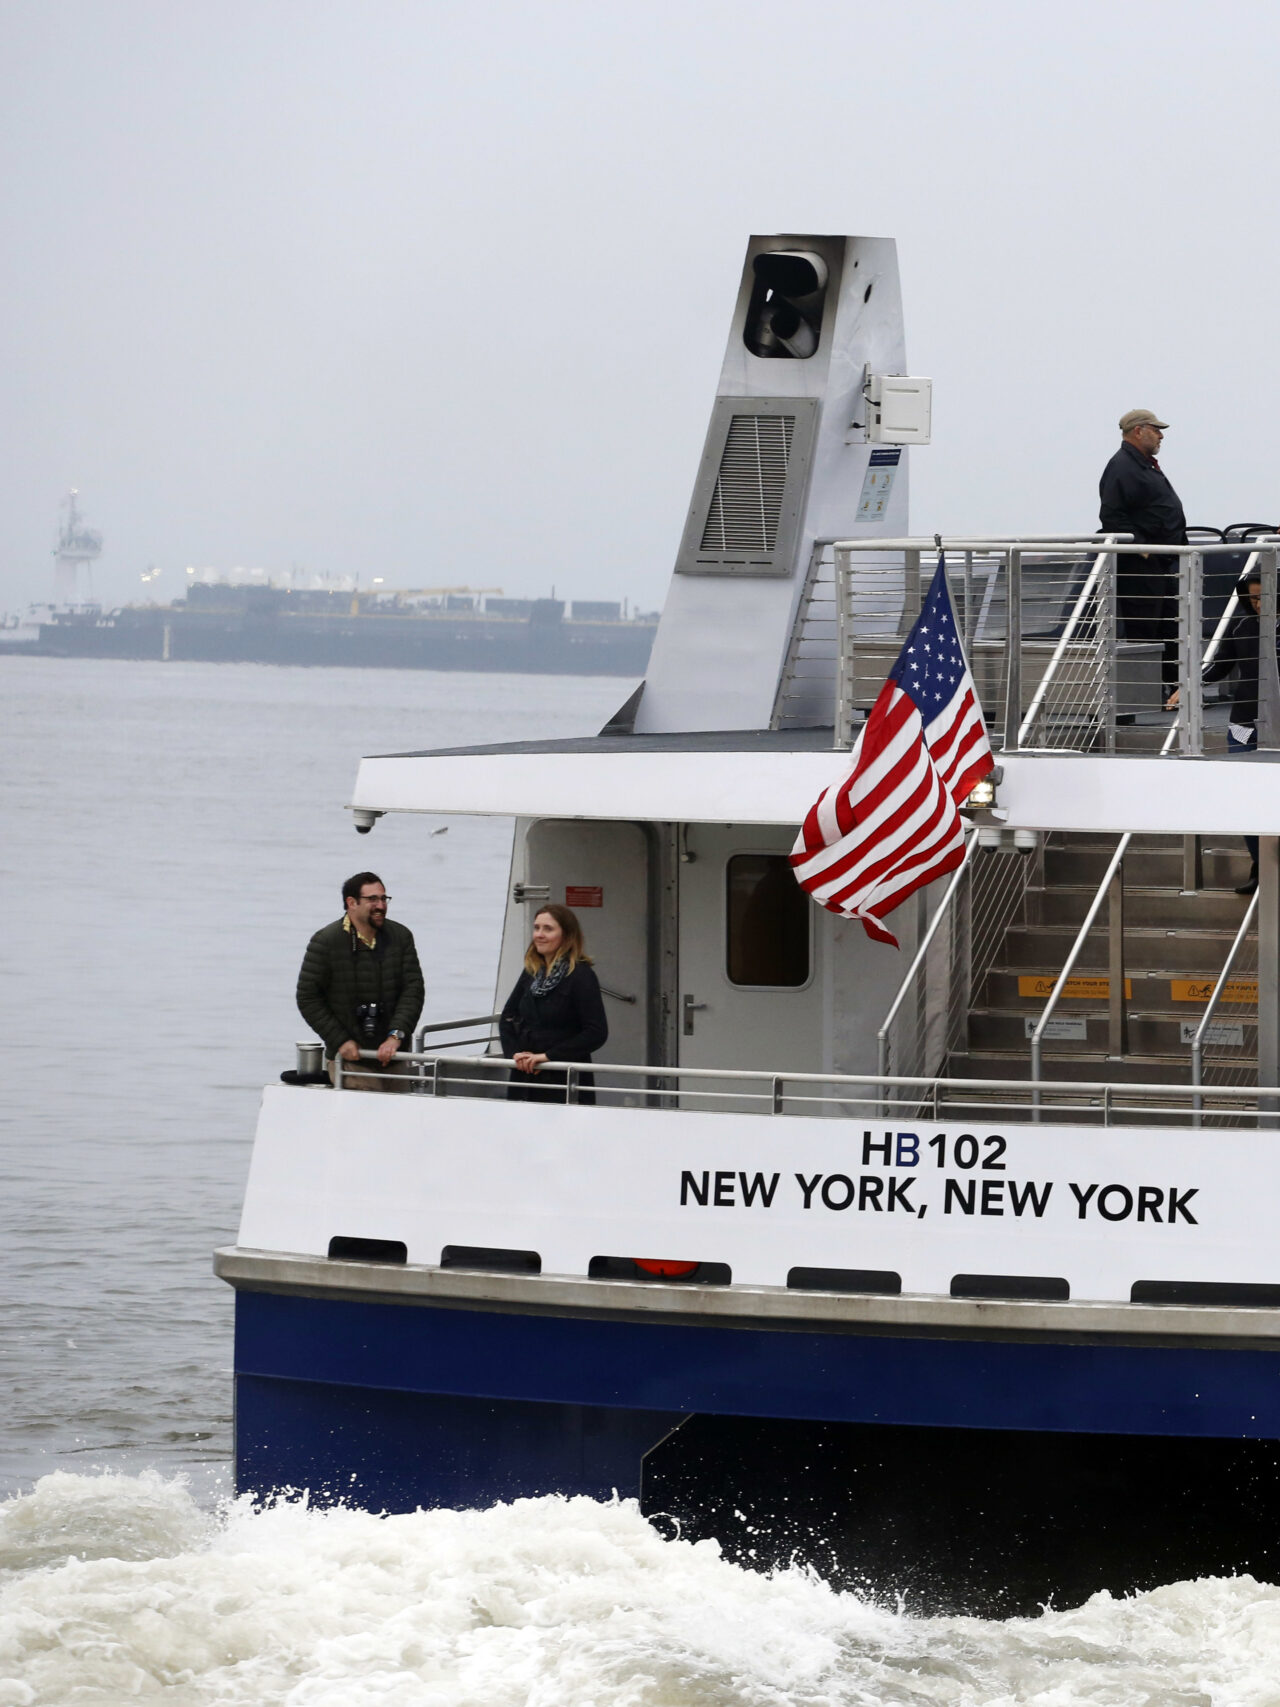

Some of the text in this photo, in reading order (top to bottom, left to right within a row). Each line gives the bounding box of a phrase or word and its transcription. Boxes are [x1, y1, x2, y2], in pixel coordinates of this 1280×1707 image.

[679, 1170, 1200, 1225] NEW YORK, NEW YORK
